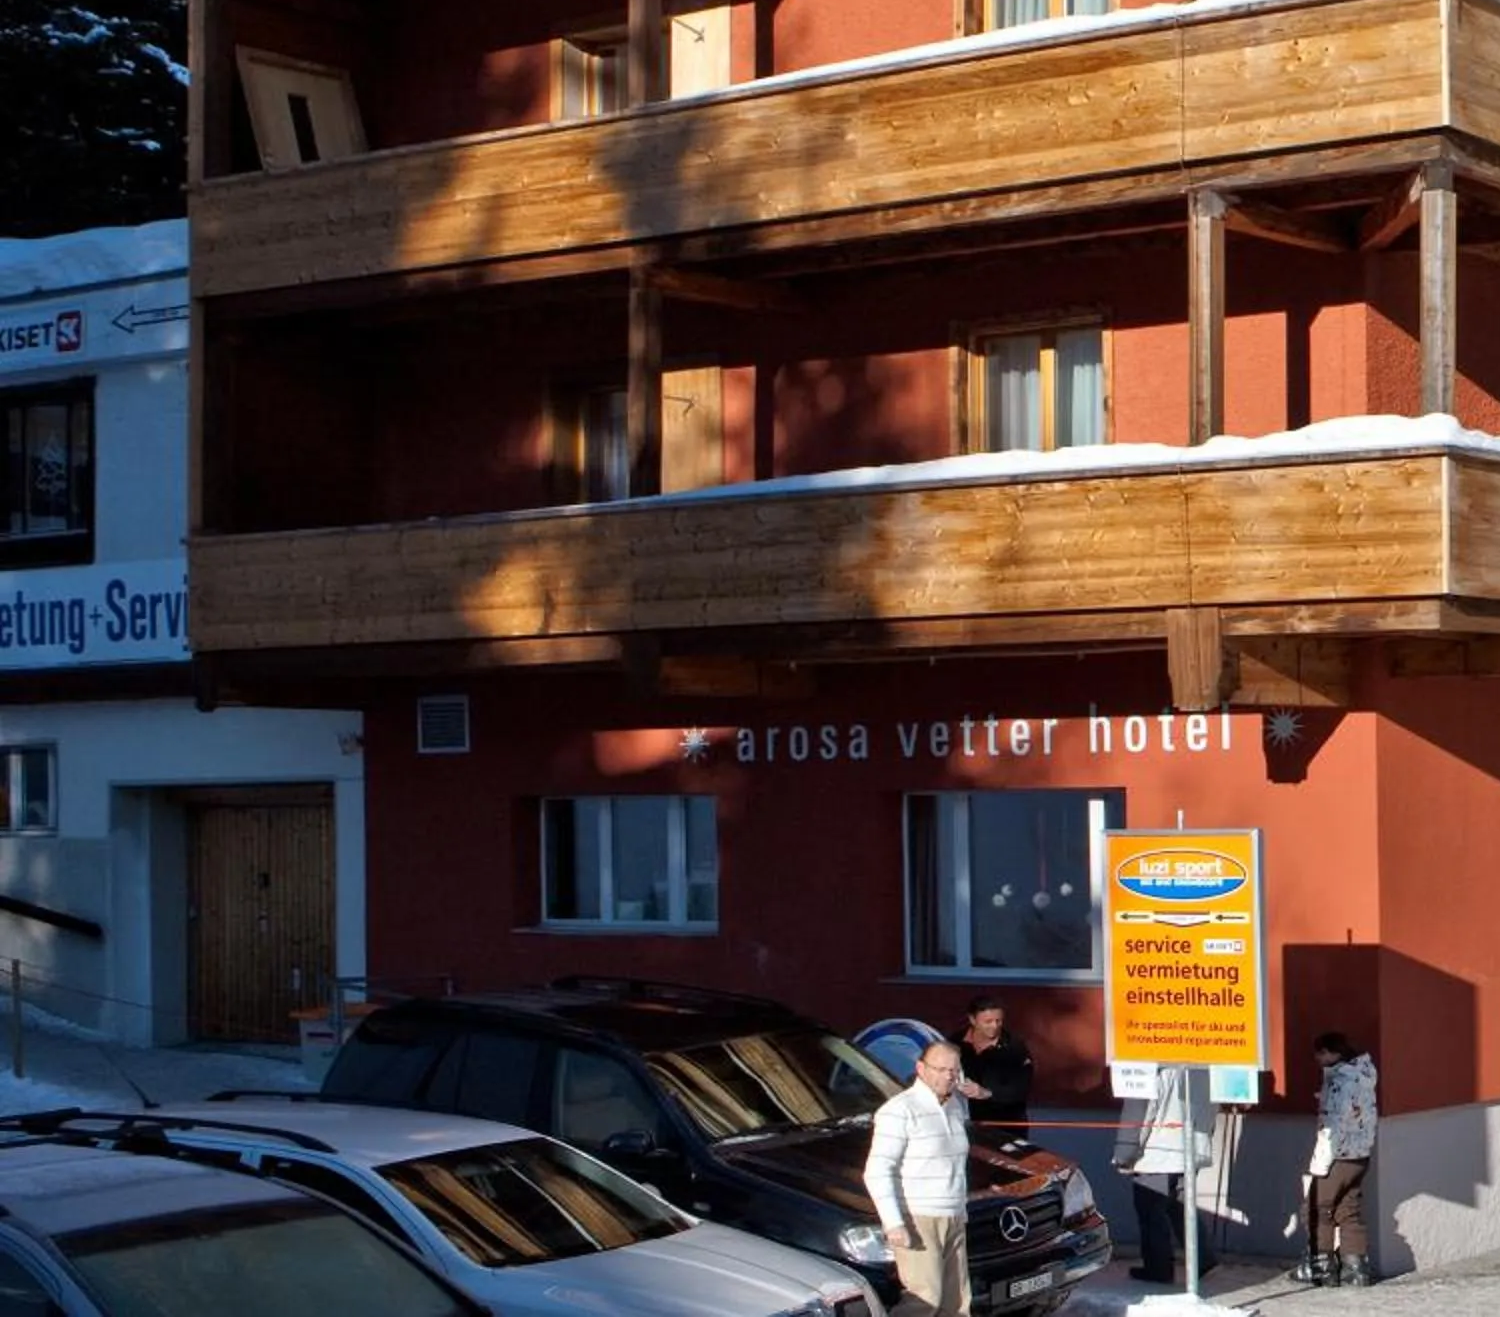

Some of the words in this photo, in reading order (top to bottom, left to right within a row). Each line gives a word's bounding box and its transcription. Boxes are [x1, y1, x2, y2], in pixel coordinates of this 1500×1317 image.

[736, 723, 869, 762] arosa
[896, 711, 1058, 758] vetter
[1088, 701, 1231, 754] hotel
[1175, 856, 1223, 878] sport
[1124, 934, 1191, 954] service
[1125, 960, 1239, 985] vermietung
[1126, 986, 1245, 1007] einstellhalle
[1225, 1021, 1246, 1032] und
